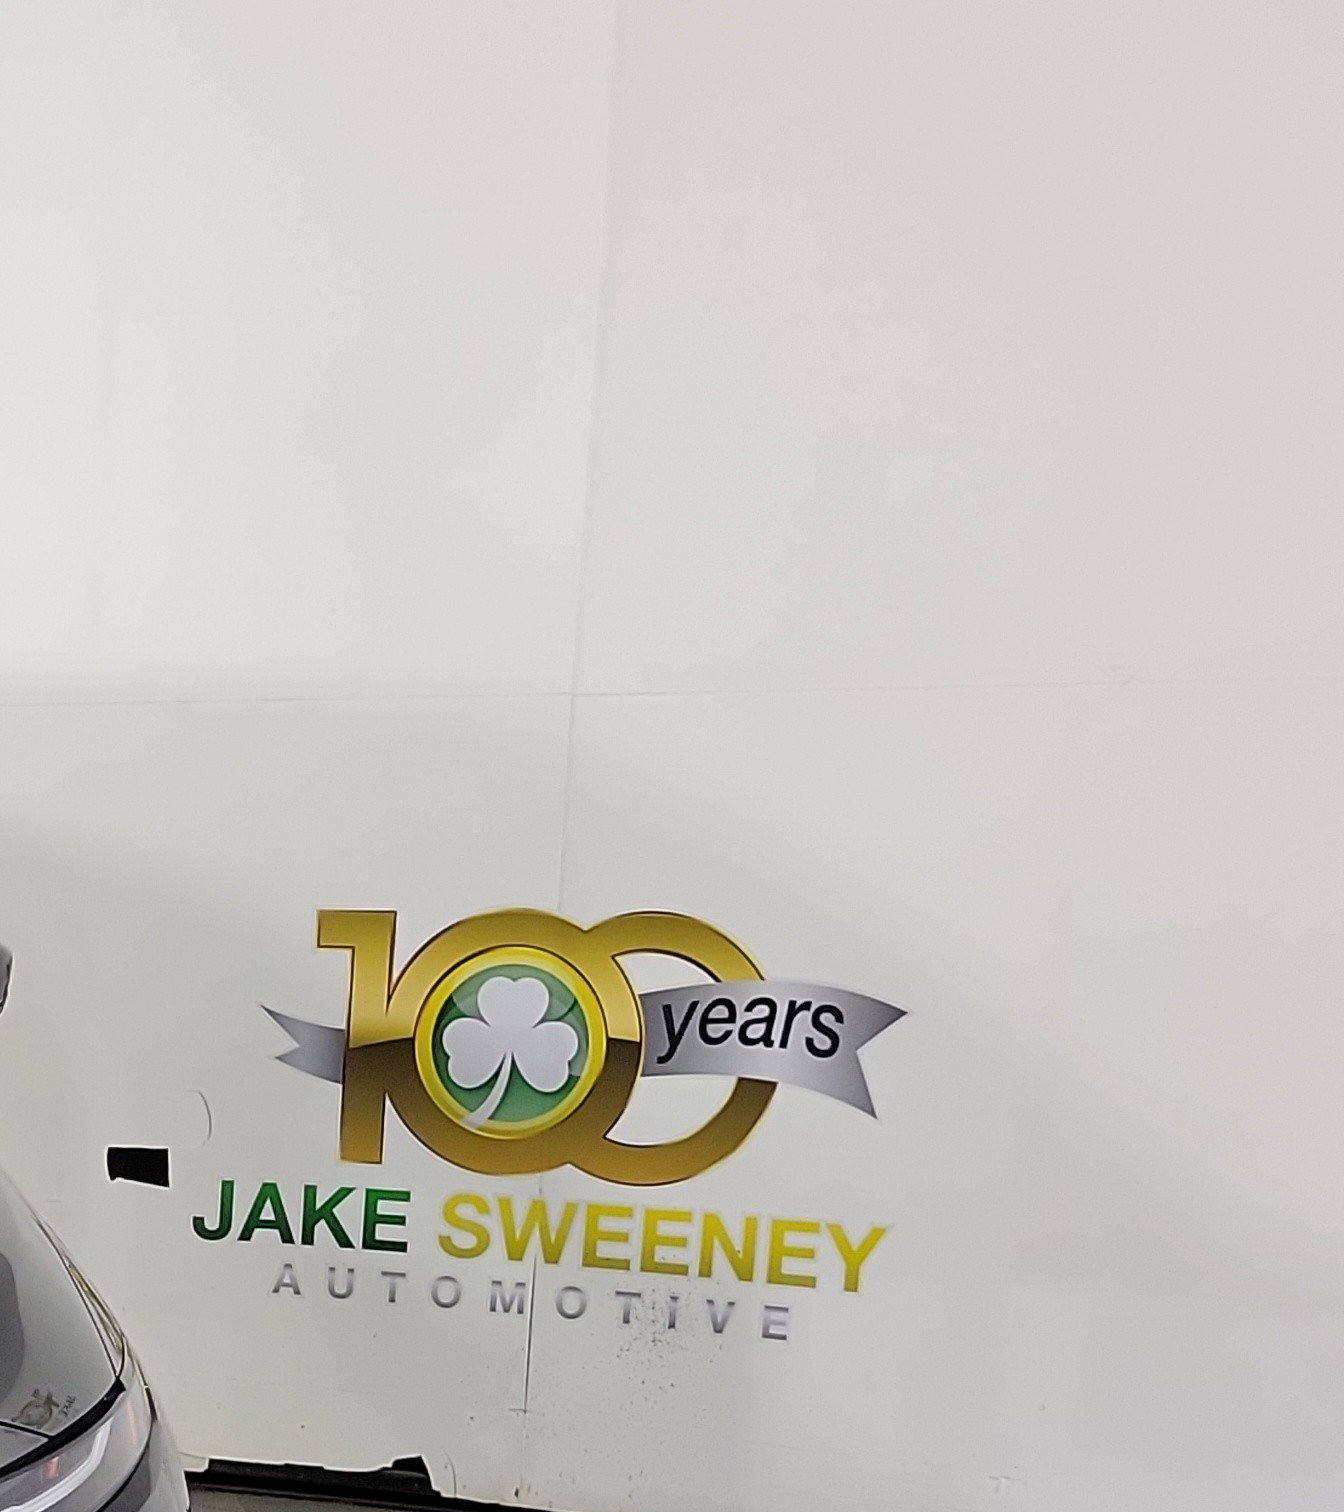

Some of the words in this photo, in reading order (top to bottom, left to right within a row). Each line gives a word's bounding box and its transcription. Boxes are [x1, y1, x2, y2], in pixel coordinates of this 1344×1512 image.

[317, 907, 779, 1186] 100
[656, 997, 846, 1064] years
[192, 1179, 412, 1253] JAKE
[437, 1191, 889, 1293] SWEENEY
[271, 1263, 790, 1342] AUTOMOTIVE
